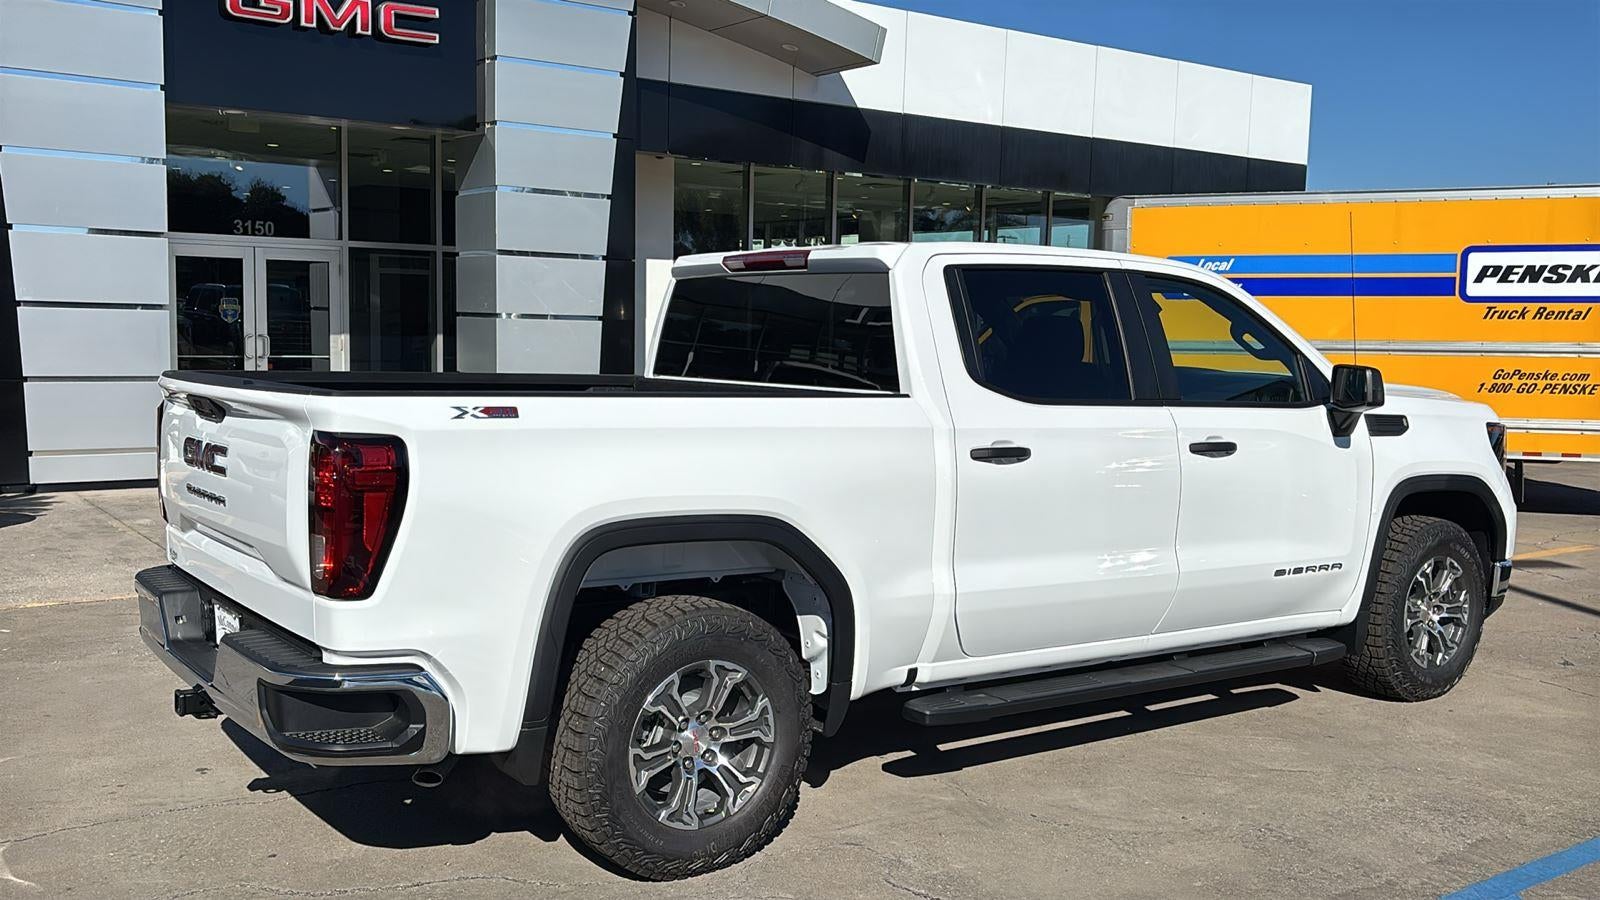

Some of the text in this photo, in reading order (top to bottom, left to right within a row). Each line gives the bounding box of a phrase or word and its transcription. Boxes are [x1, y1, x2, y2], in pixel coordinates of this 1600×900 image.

[226, 0, 439, 43] GMC
[233, 219, 275, 236] 3150
[1197, 258, 1235, 271] Local
[1472, 264, 1600, 284] PENSK
[1482, 306, 1593, 321] Truck Rental
[1492, 368, 1591, 382] GoPenske.com
[1476, 382, 1600, 396] 1-800-GO-PENSKE
[183, 436, 229, 478] GMC
[1273, 562, 1343, 578] SIERRA
